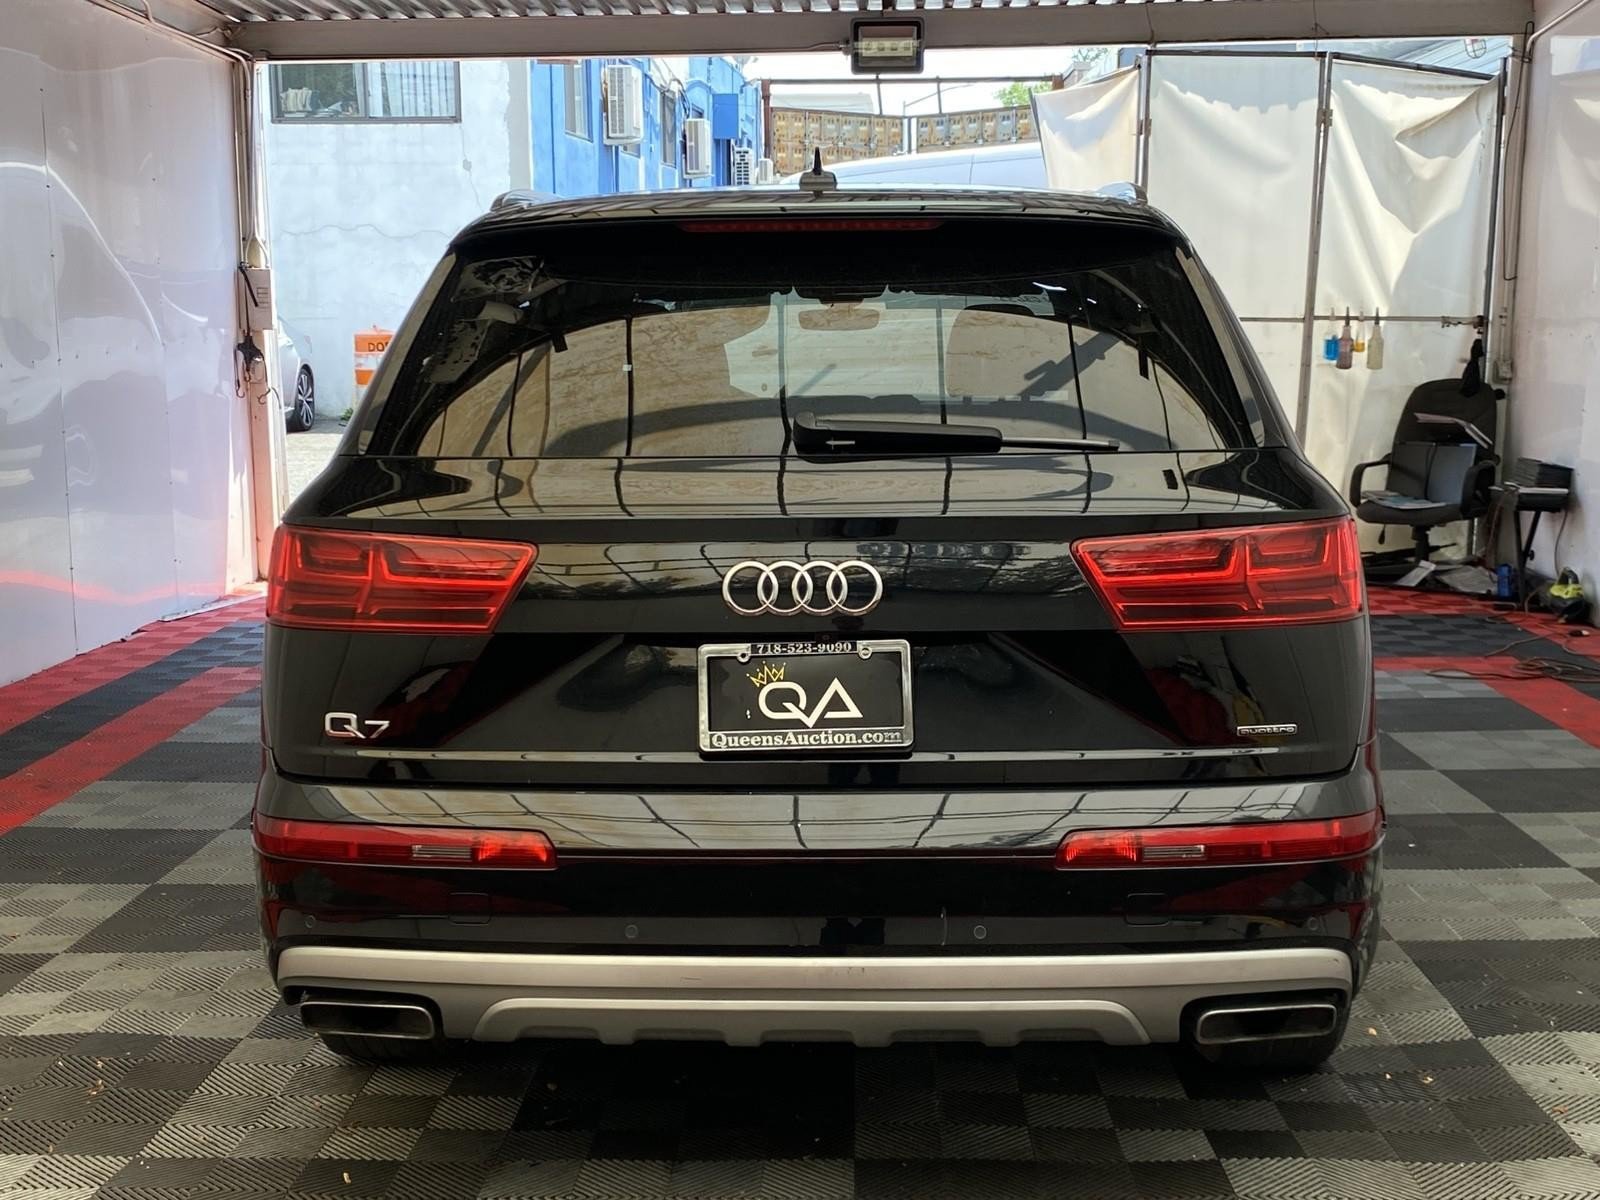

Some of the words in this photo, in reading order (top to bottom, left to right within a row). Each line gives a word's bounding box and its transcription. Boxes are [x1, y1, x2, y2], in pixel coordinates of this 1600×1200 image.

[368, 342, 389, 352] DO
[757, 642, 852, 654] 718-523-9090
[758, 677, 863, 728] QA
[325, 712, 390, 739] Q7
[1240, 727, 1295, 735] quattro
[711, 730, 903, 747] QueensAuction.com
